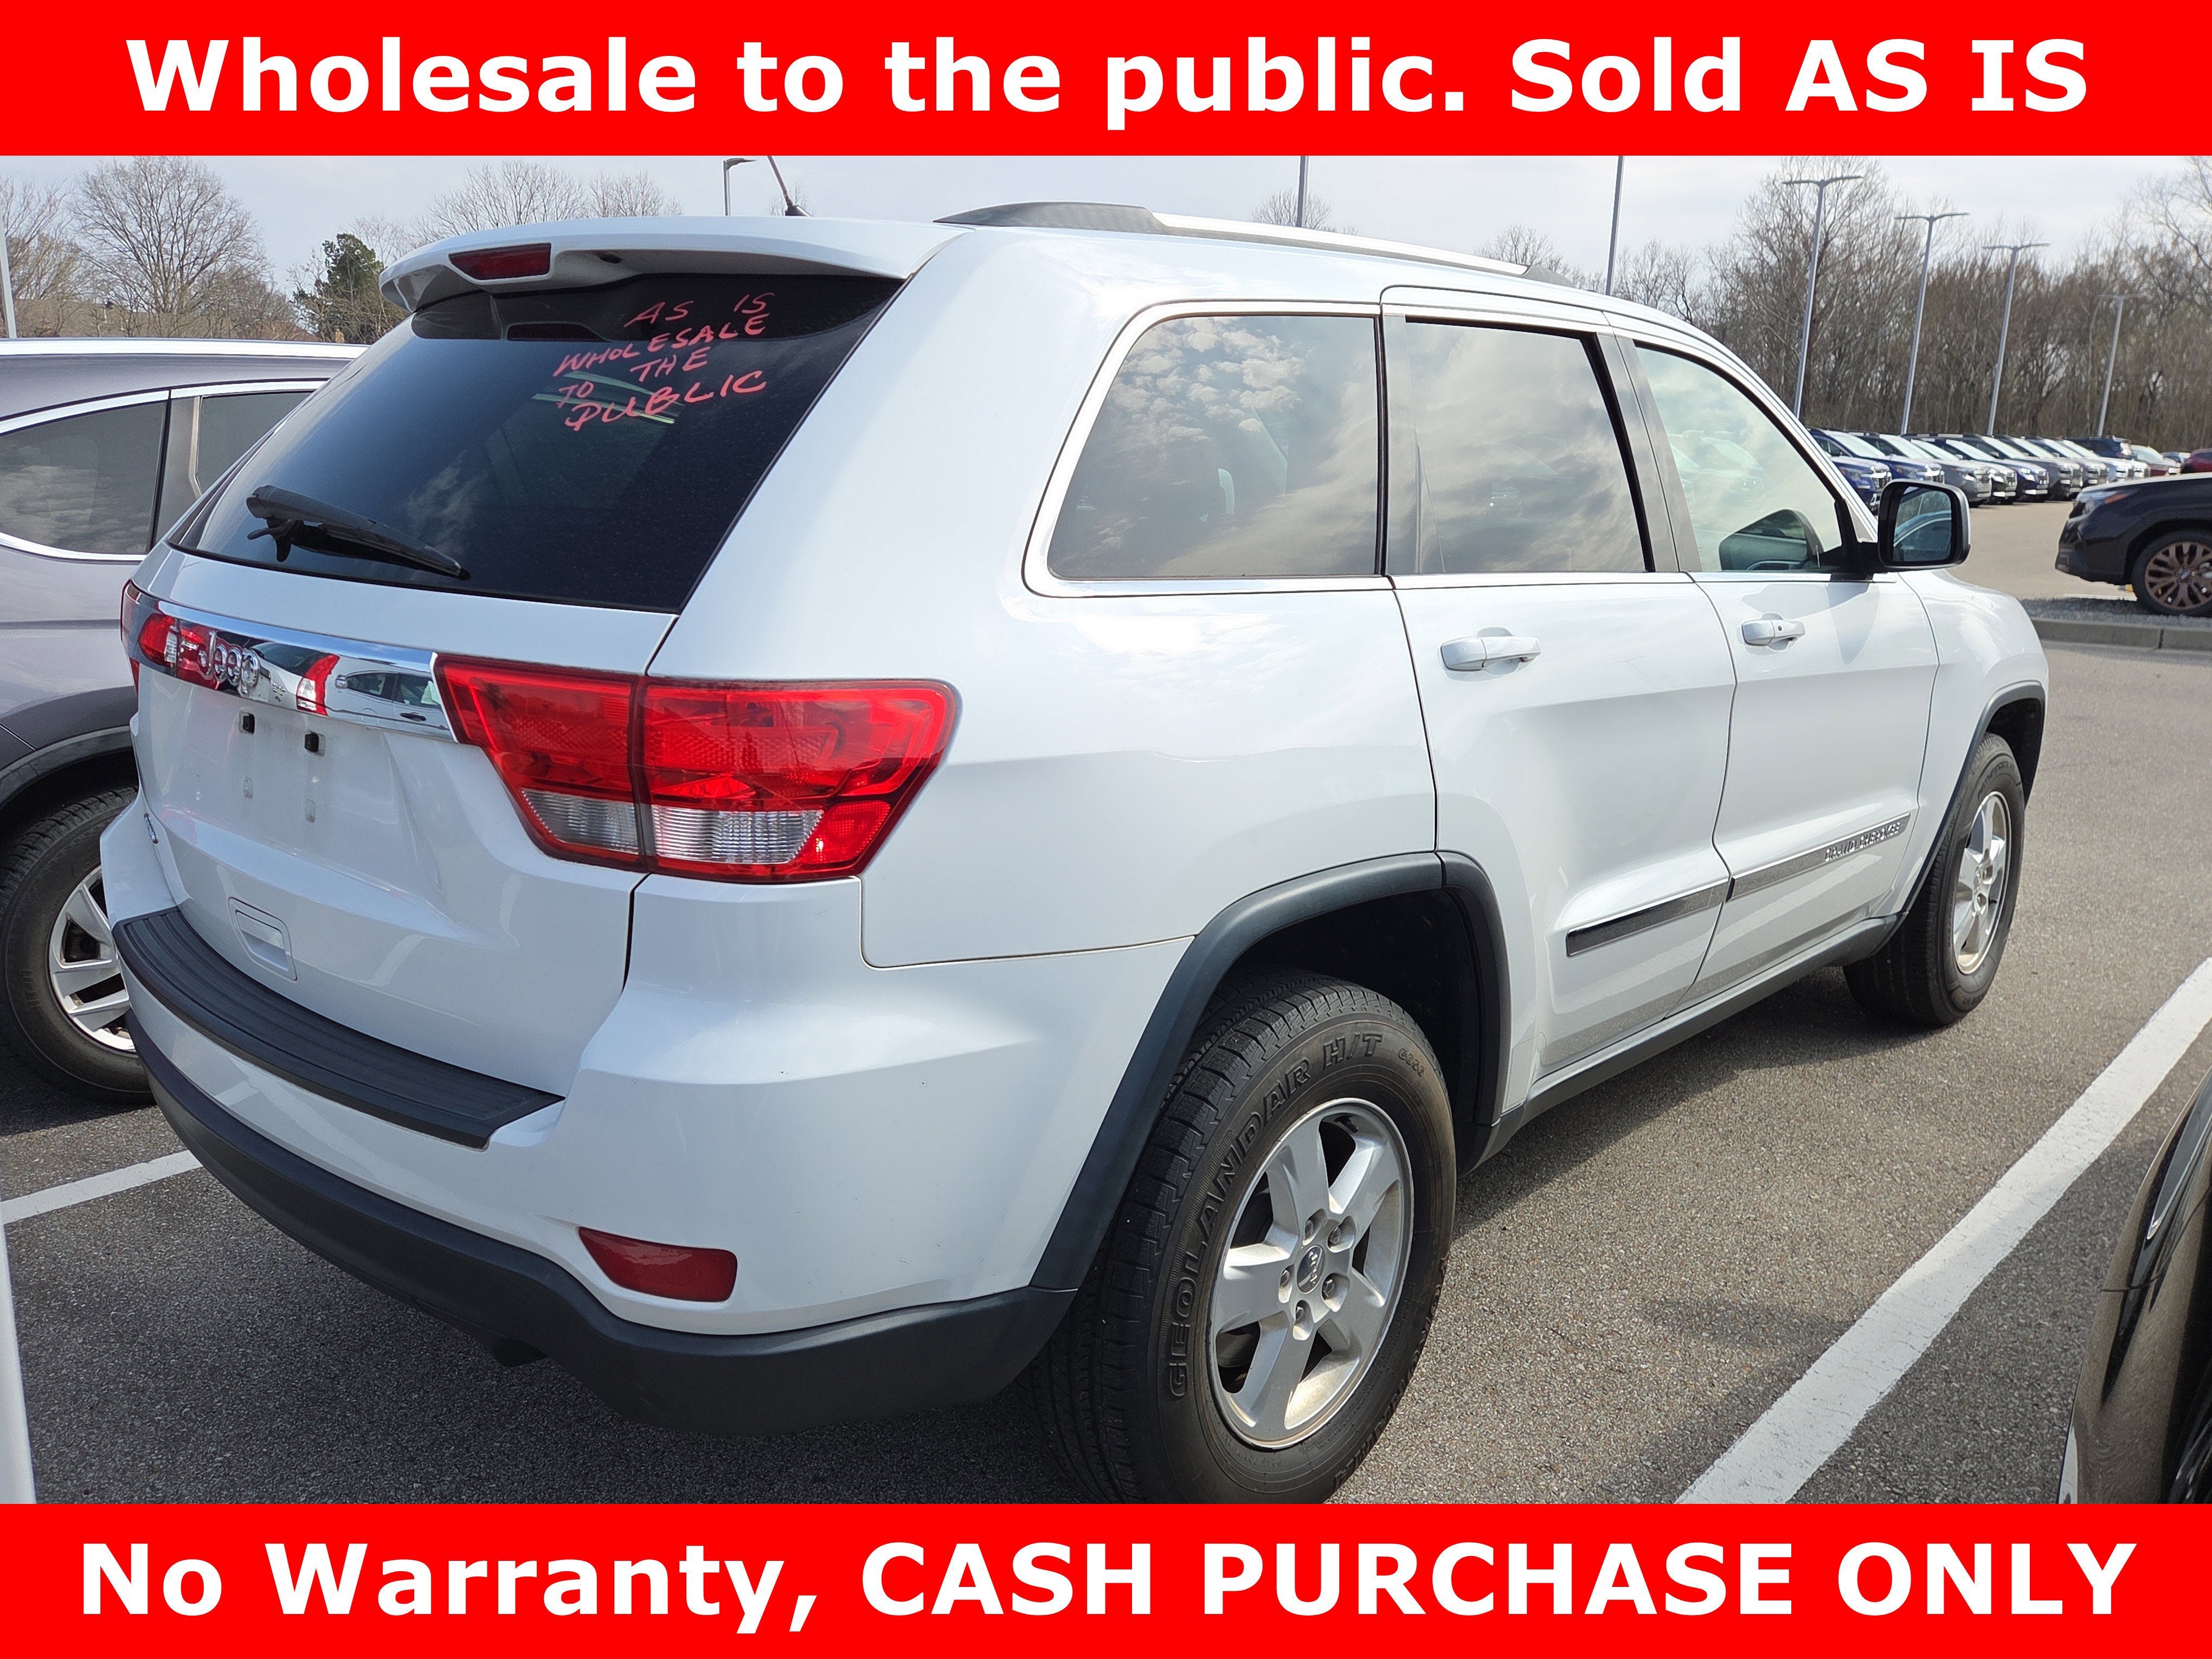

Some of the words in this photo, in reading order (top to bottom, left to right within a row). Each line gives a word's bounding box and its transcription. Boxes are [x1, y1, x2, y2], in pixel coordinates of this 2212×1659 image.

[623, 300, 694, 327] AS
[734, 292, 775, 314] IS
[552, 313, 770, 376] WHOLESALE
[556, 380, 595, 409] TO
[629, 346, 711, 382] THE
[564, 370, 767, 431] PUBLIC
[198, 630, 259, 695] Jeep
[1169, 1058, 1311, 1397] GEOLANDAR
[1322, 1032, 1382, 1071] H/T
